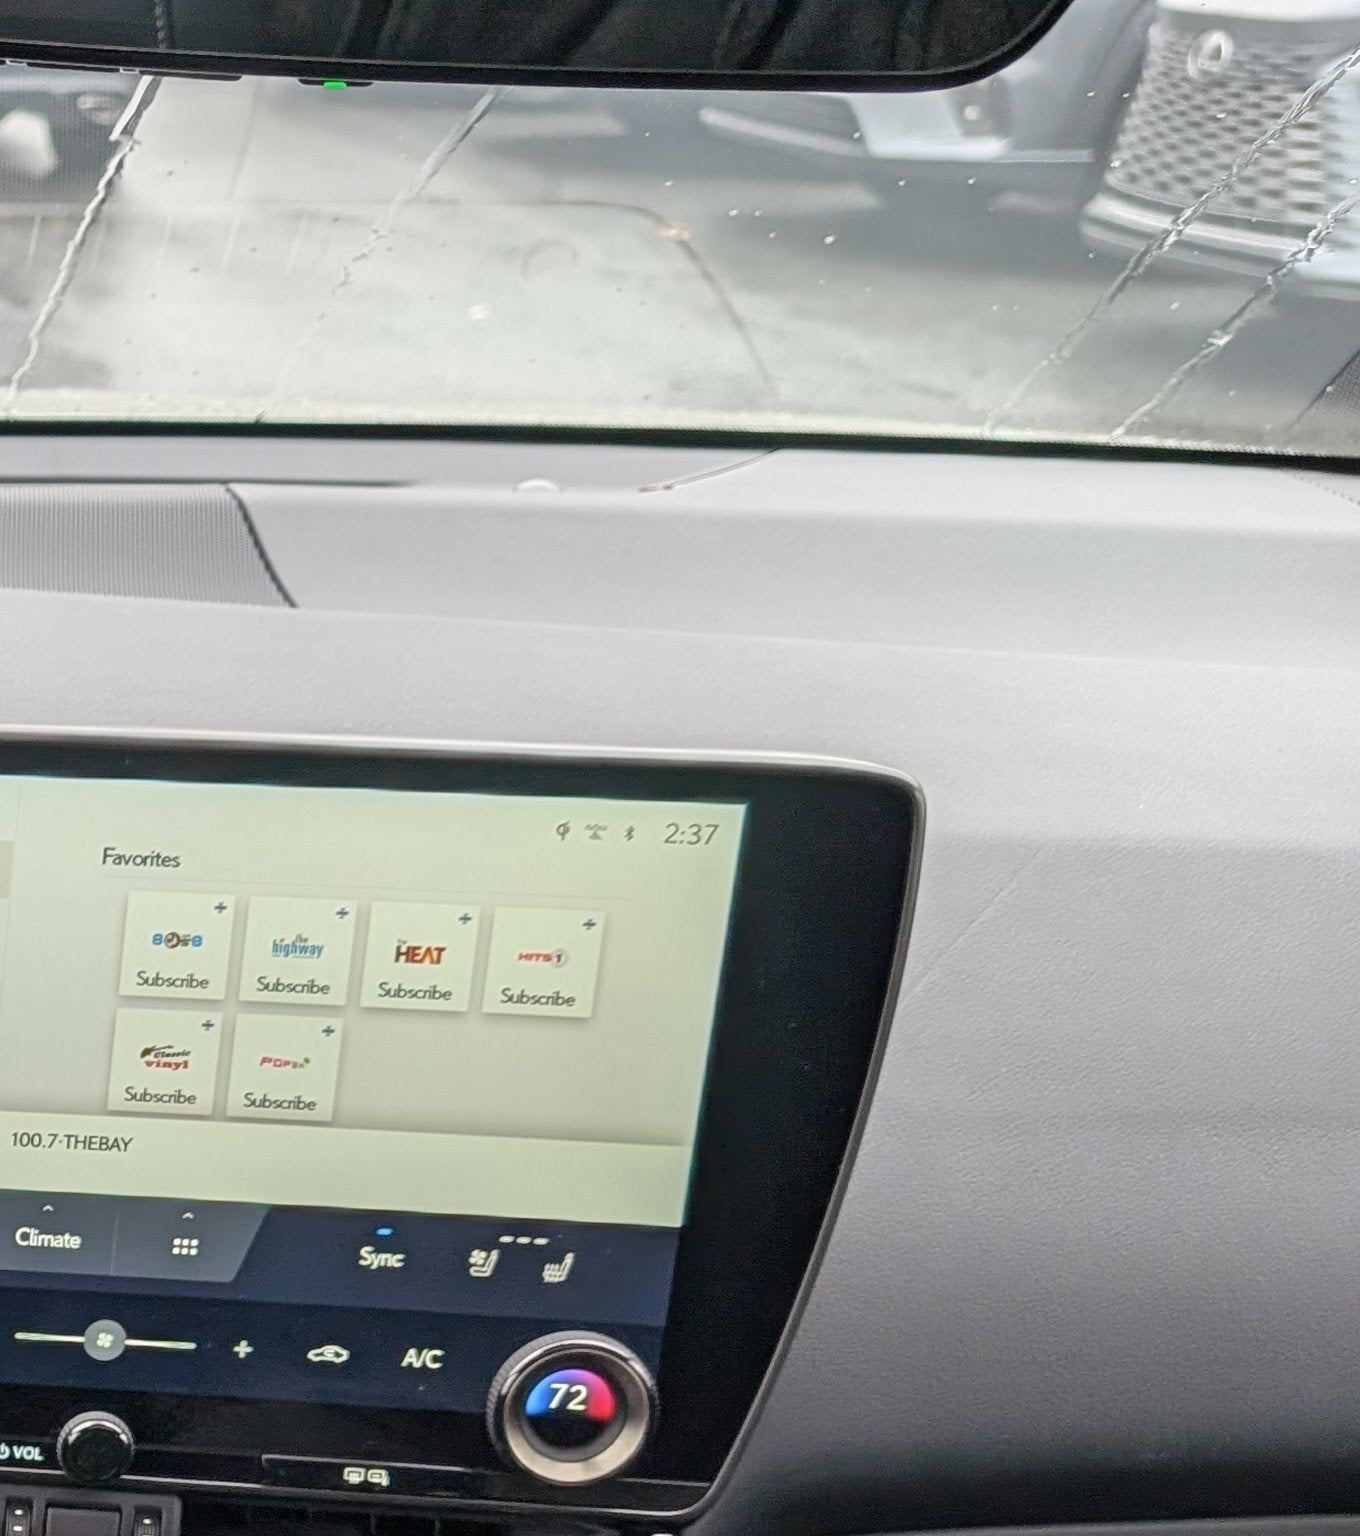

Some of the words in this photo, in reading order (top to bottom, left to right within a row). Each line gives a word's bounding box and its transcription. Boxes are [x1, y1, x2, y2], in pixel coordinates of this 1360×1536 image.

[664, 822, 720, 846] 2:37
[101, 847, 181, 870] Favorites
[271, 939, 324, 958] highway
[394, 944, 447, 965] HEAT
[136, 971, 210, 991] Subscribe
[256, 976, 331, 997] Subscribe
[377, 982, 453, 1003] Subscribe
[499, 986, 576, 1008] Subscribe
[144, 1059, 189, 1071] vinyl
[124, 1086, 197, 1107] Subscribe
[243, 1091, 318, 1113] Subscribe
[15, 1227, 82, 1250] Climate
[358, 1246, 405, 1270] Sync
[401, 1347, 445, 1370] A/C
[549, 1383, 588, 1412] 72
[13, 1445, 45, 1462] VOL
